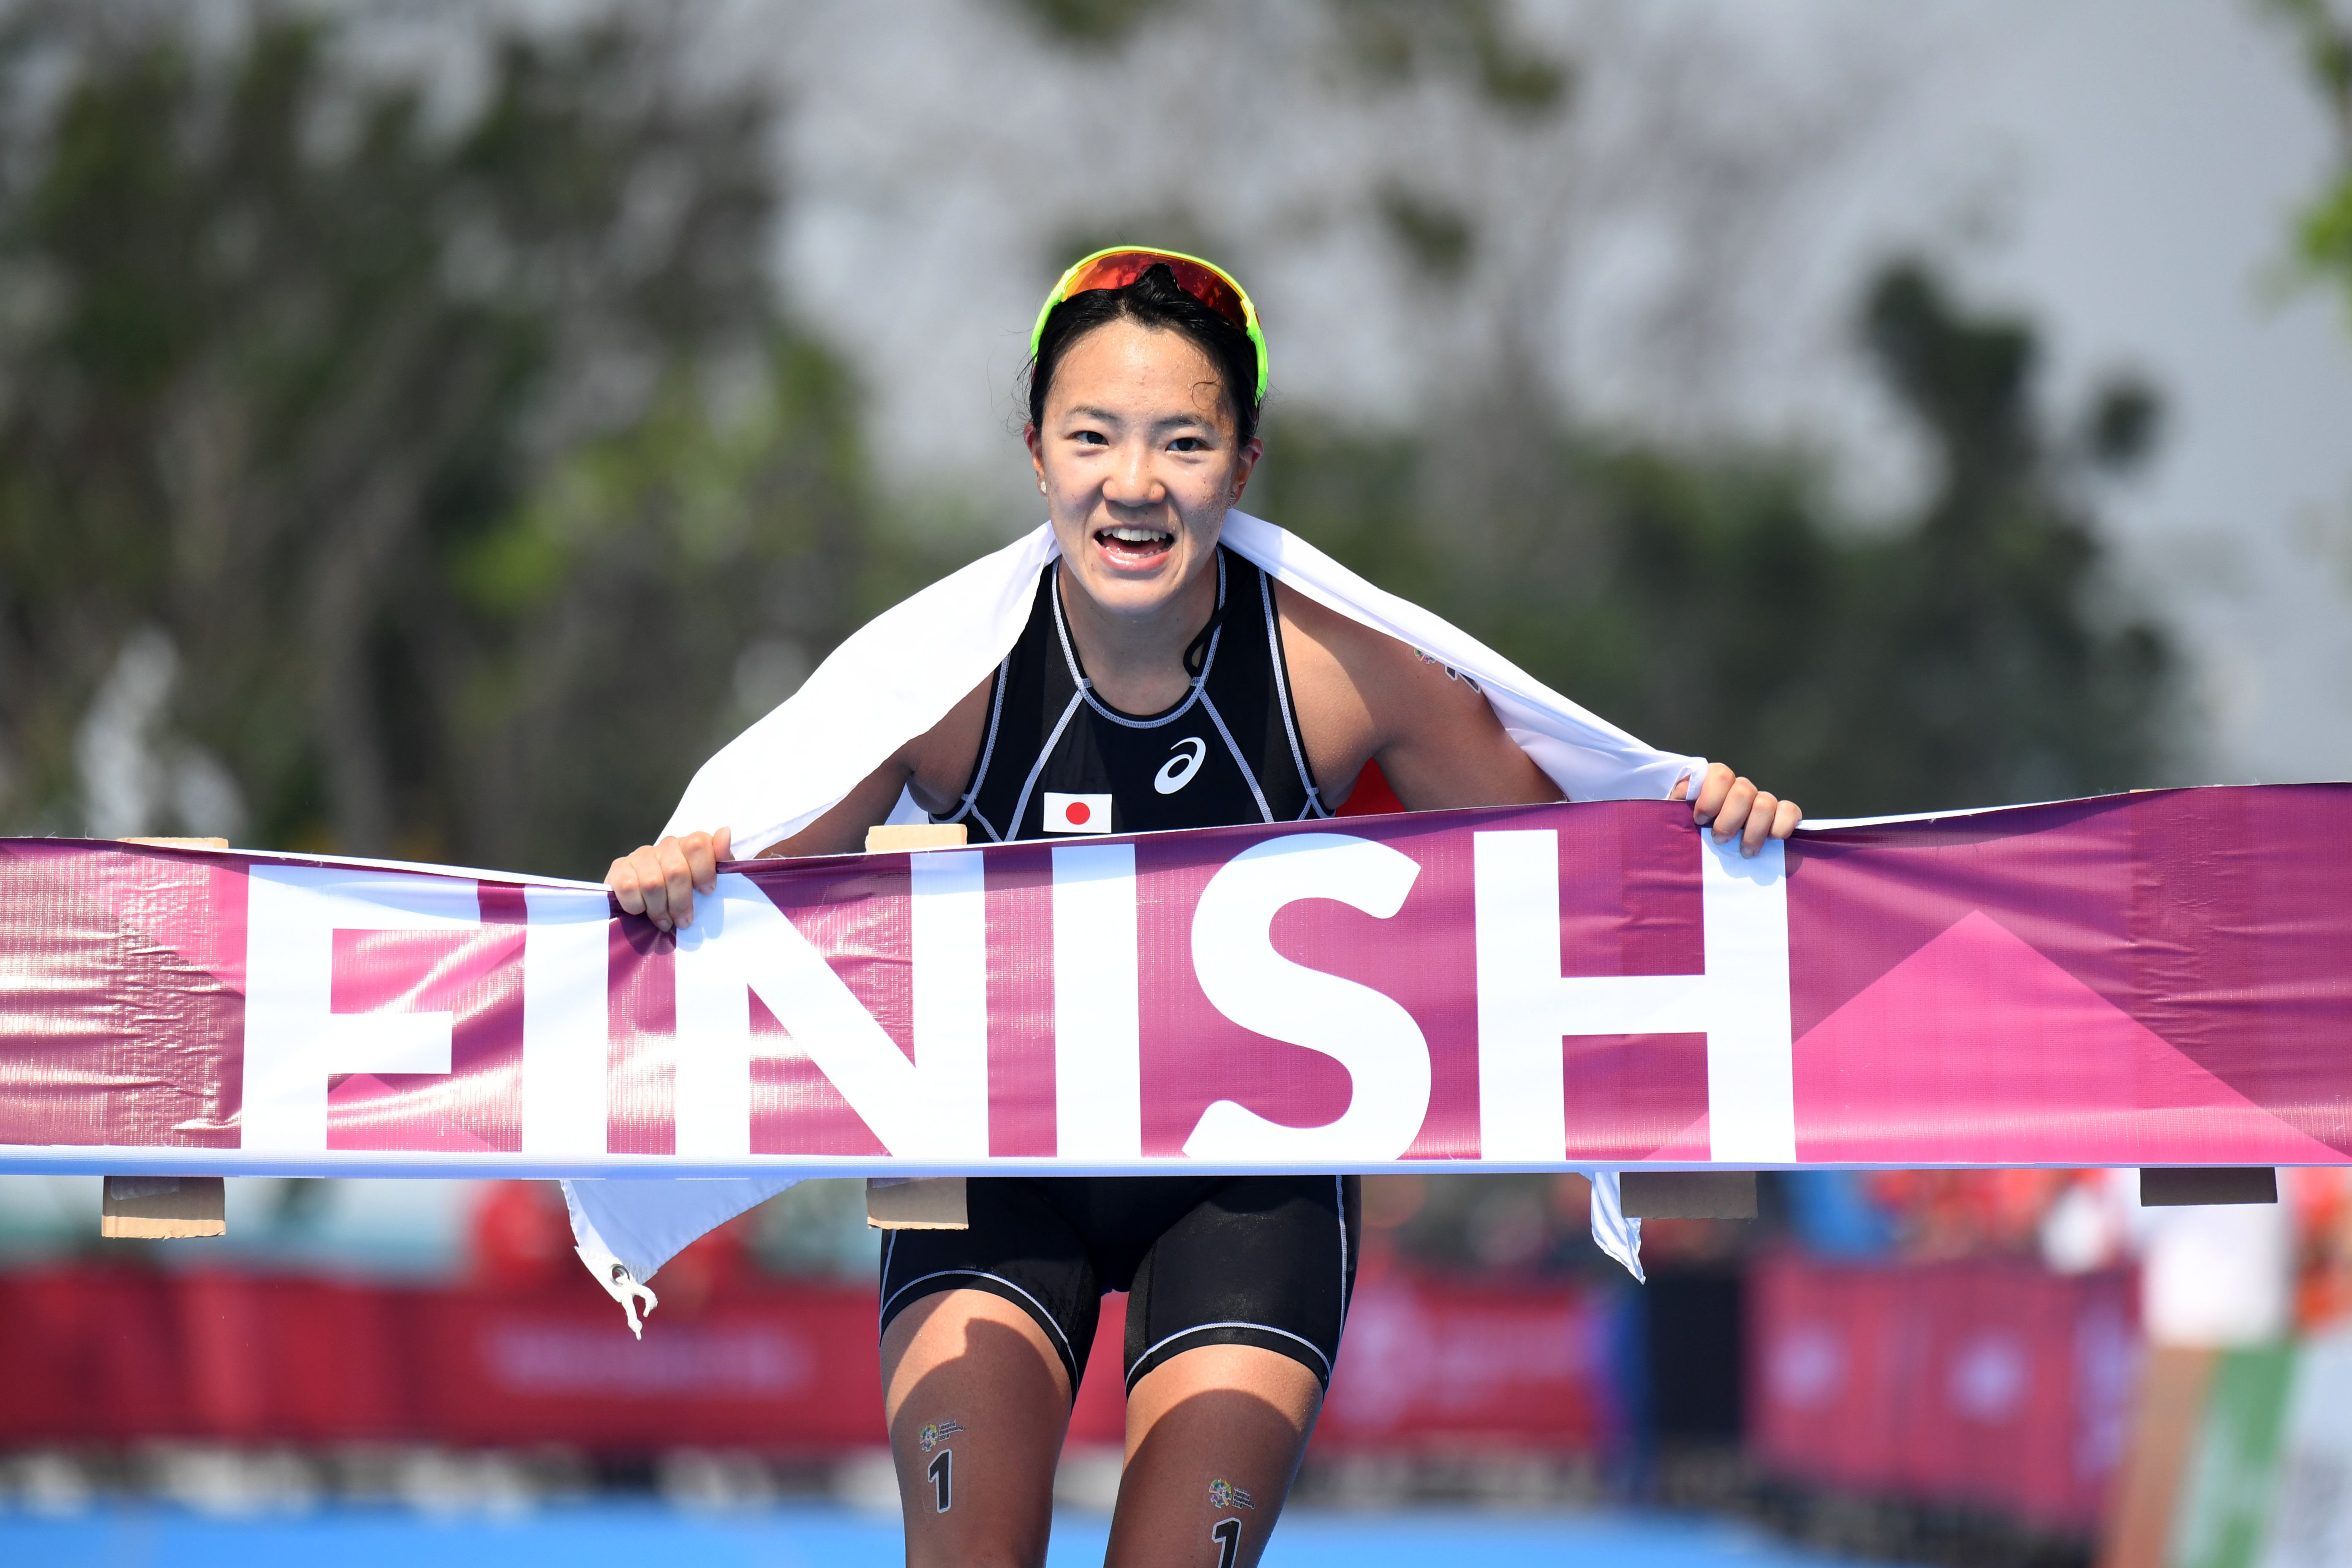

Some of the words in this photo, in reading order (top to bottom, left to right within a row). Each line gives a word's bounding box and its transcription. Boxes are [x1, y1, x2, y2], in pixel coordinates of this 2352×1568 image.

[240, 829, 1797, 1163] FINISH
[928, 1449, 952, 1514] 1
[1211, 1517, 1242, 1568] 1
